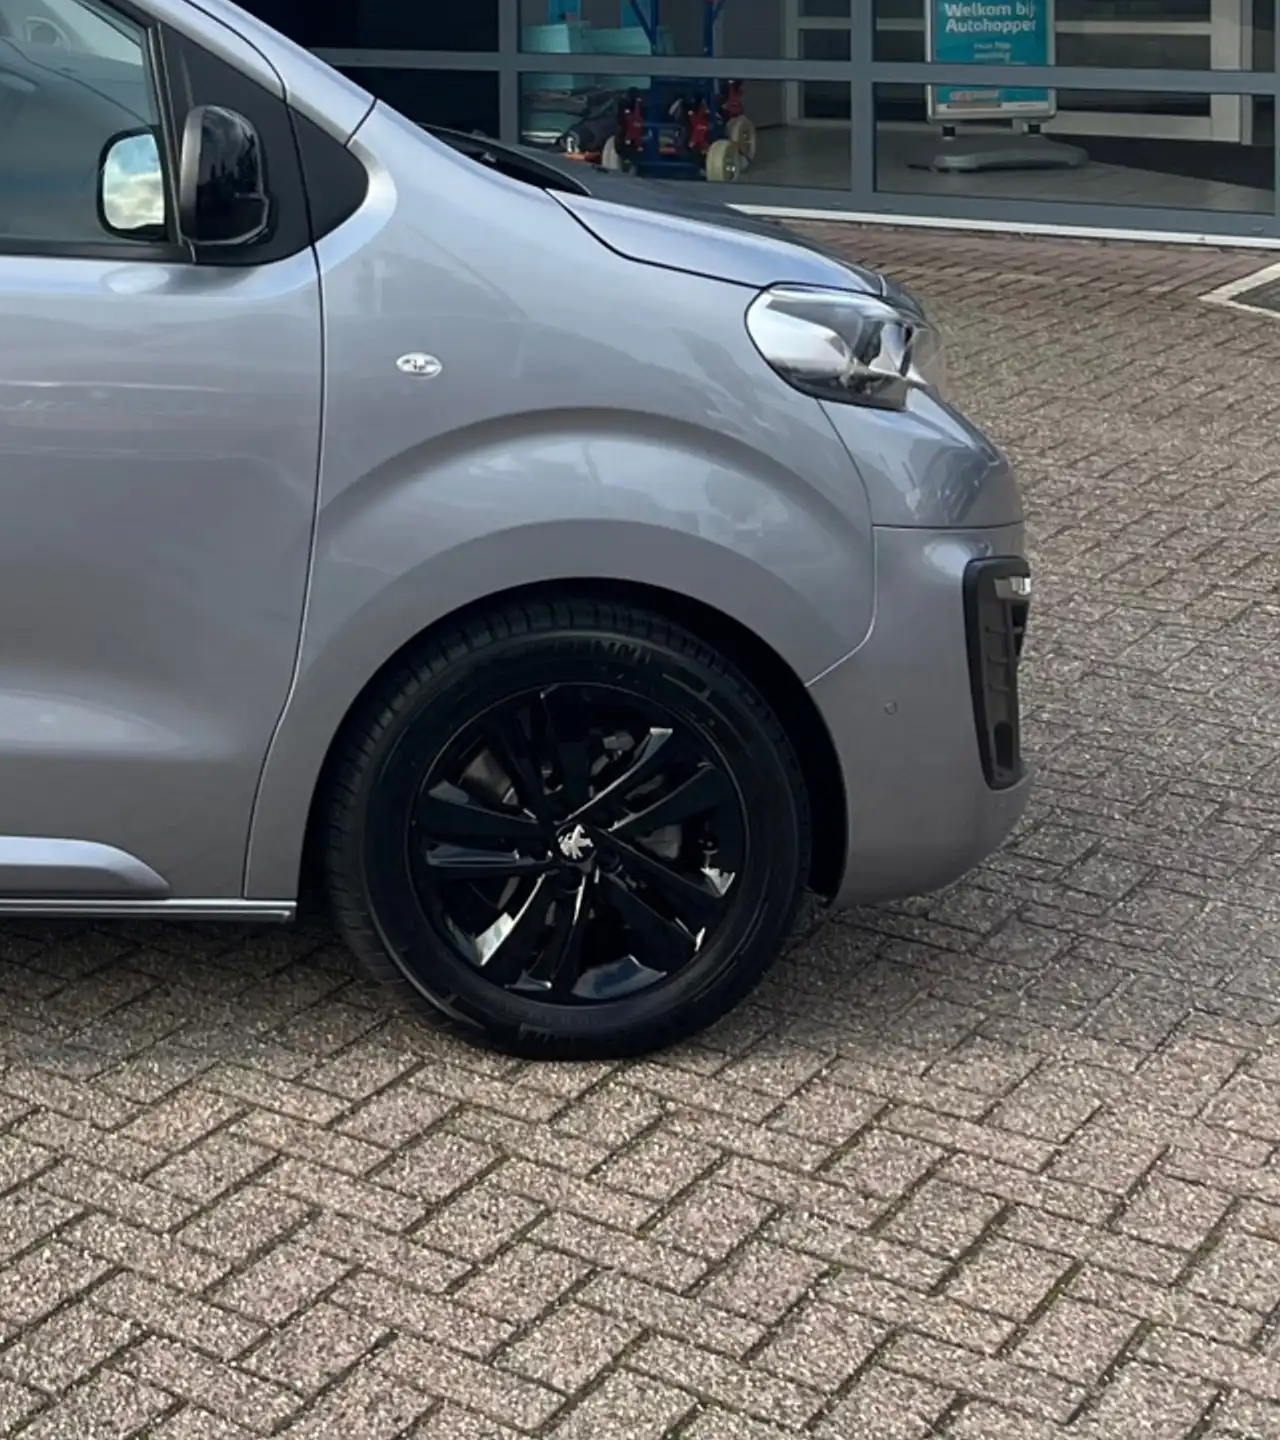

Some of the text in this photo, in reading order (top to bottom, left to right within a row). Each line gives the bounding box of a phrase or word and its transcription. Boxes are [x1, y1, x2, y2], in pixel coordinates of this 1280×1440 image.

[943, 0, 1037, 18] Welkom bij
[944, 17, 1037, 34] Autohopper
